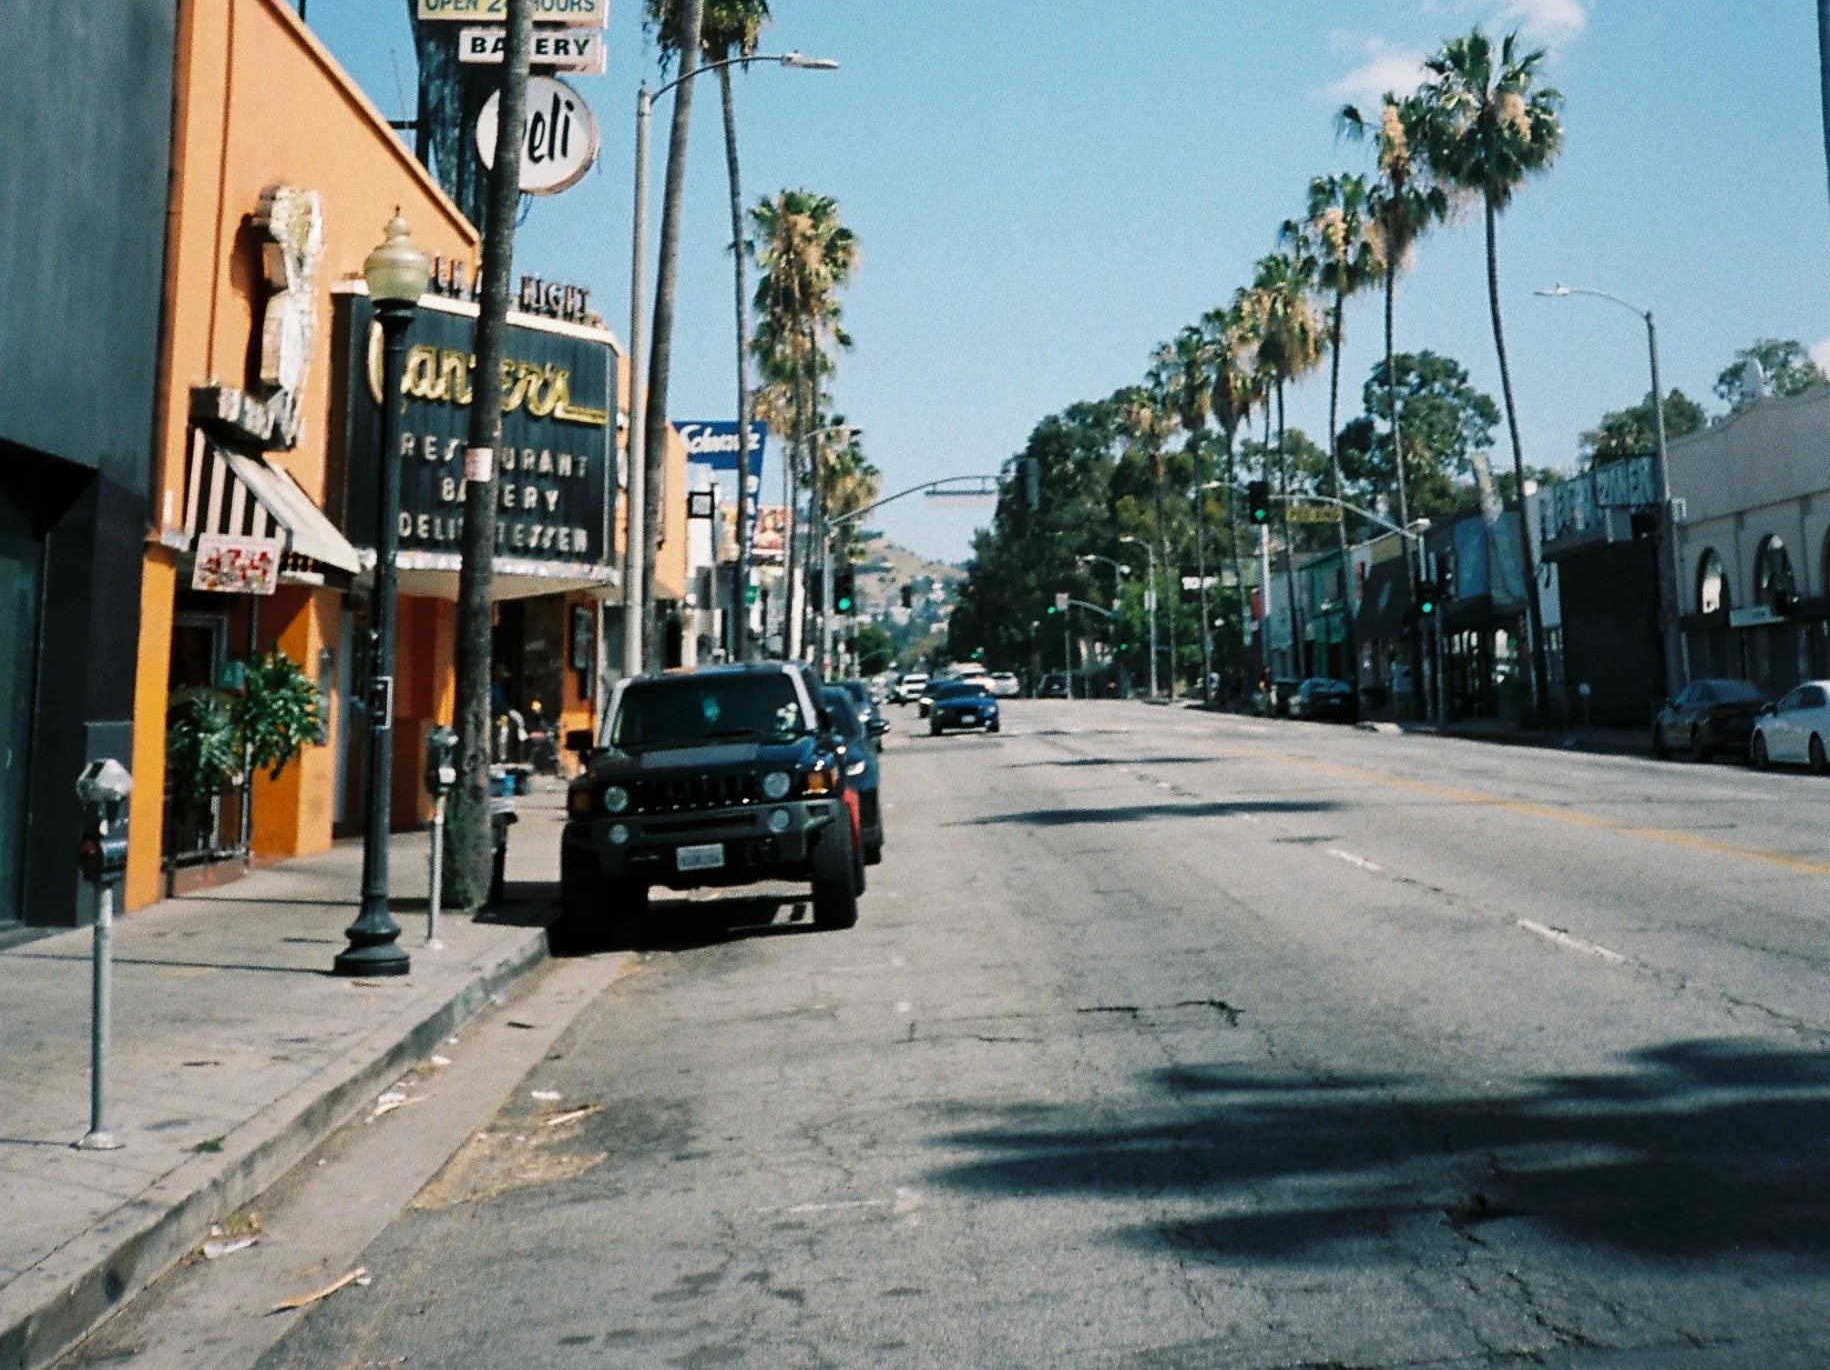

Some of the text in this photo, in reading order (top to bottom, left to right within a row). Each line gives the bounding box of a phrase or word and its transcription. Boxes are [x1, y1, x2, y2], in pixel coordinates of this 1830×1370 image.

[471, 36, 590, 56] BAERY
[523, 92, 575, 164] eli
[401, 432, 588, 478] RESURANT
[441, 477, 560, 512] BAERY
[399, 512, 588, 553] DELITESSEN
